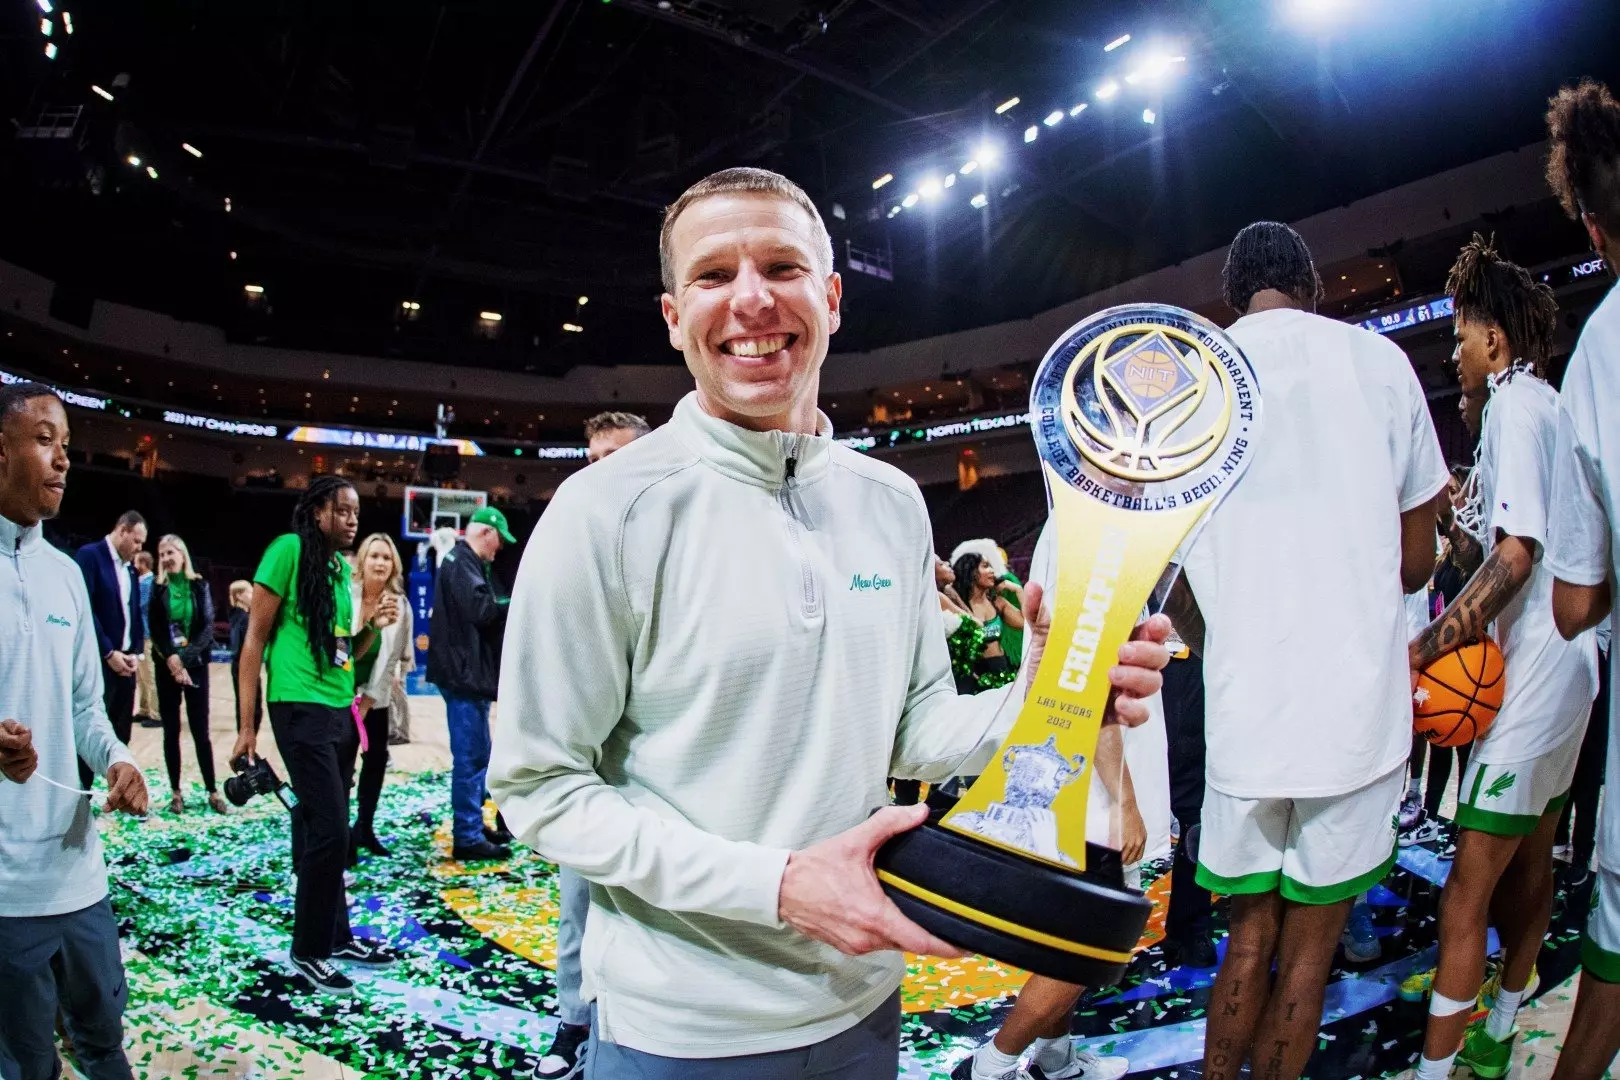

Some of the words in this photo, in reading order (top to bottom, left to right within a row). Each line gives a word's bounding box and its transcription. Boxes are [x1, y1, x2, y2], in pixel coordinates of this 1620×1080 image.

[1417, 308, 1431, 322] 61
[1128, 363, 1175, 384] NIT
[1197, 330, 1253, 422] TOURNAMENT
[185, 414, 206, 428] NIT
[205, 418, 278, 437] CHAMPIONS
[926, 423, 971, 441] NORTH
[970, 414, 1015, 432] TEXAS
[538, 447, 584, 459] NORTH
[1041, 407, 1071, 468] COLLEGE
[1066, 465, 1177, 511] BASKETBALL'S
[417, 585, 427, 620] NIT
[1036, 695, 1057, 709] LAS
[1060, 701, 1093, 719] VEGAS
[1046, 714, 1072, 730] 2023
